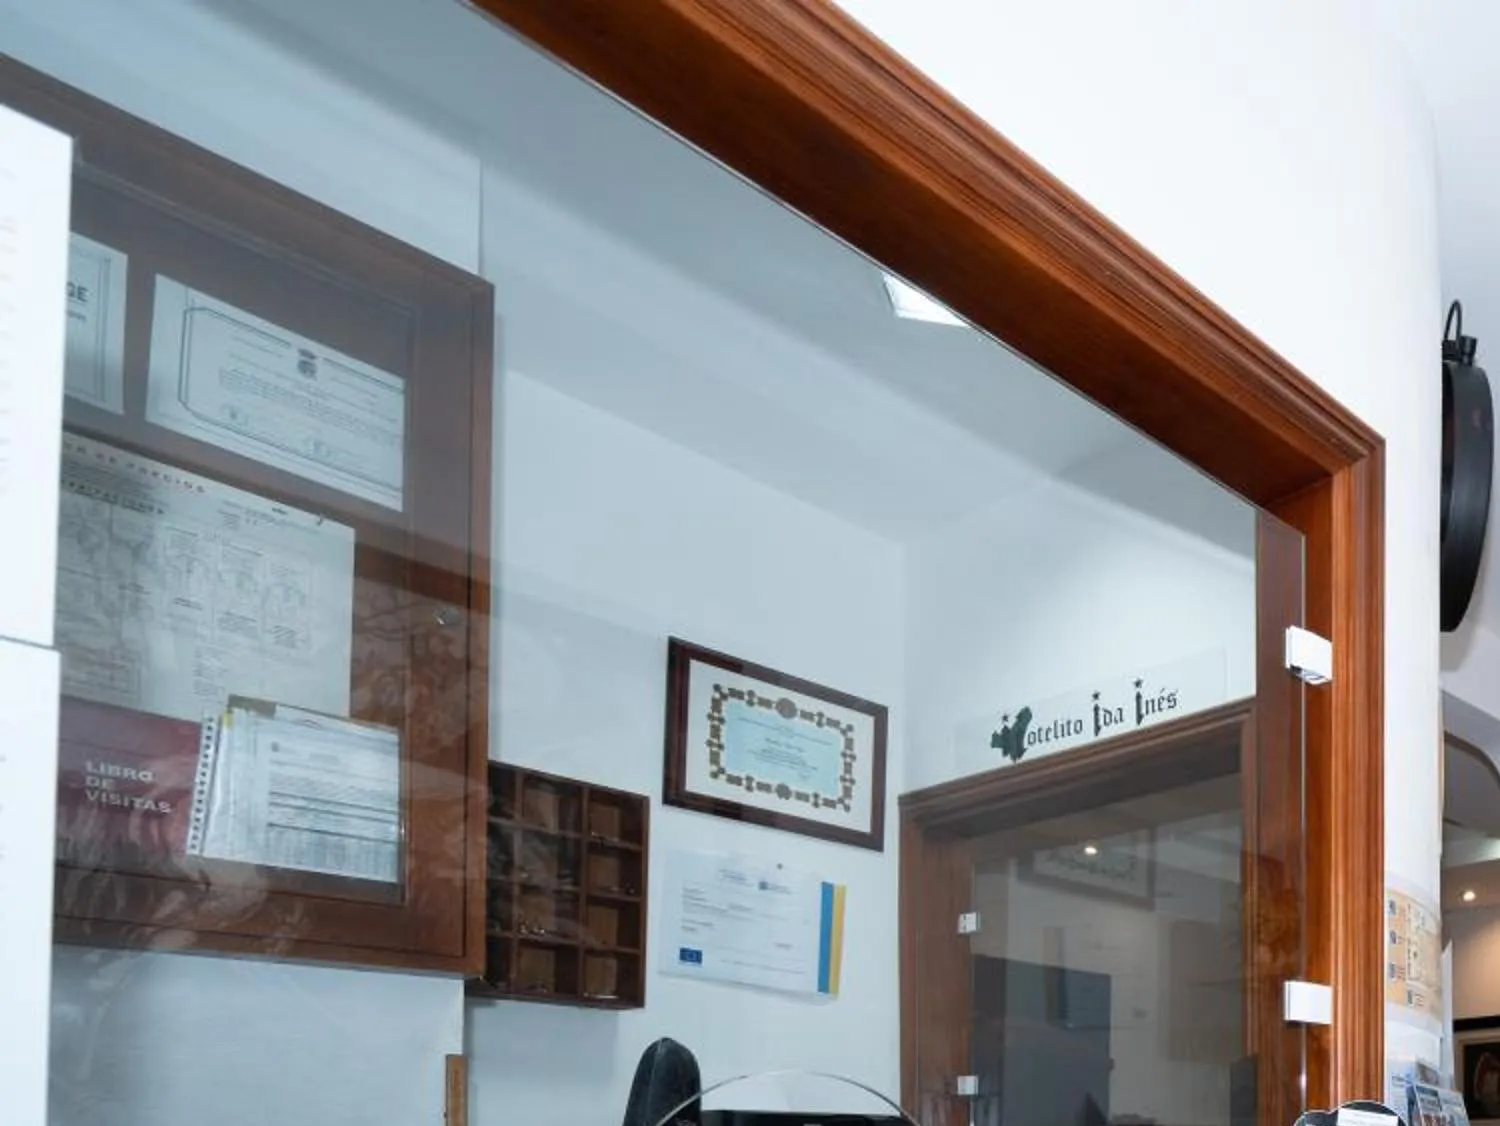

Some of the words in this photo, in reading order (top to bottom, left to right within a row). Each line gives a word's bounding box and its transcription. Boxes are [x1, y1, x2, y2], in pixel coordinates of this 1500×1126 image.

[85, 759, 154, 783] LIBRO
[85, 775, 113, 791] DE
[85, 789, 173, 814] VISITAS
